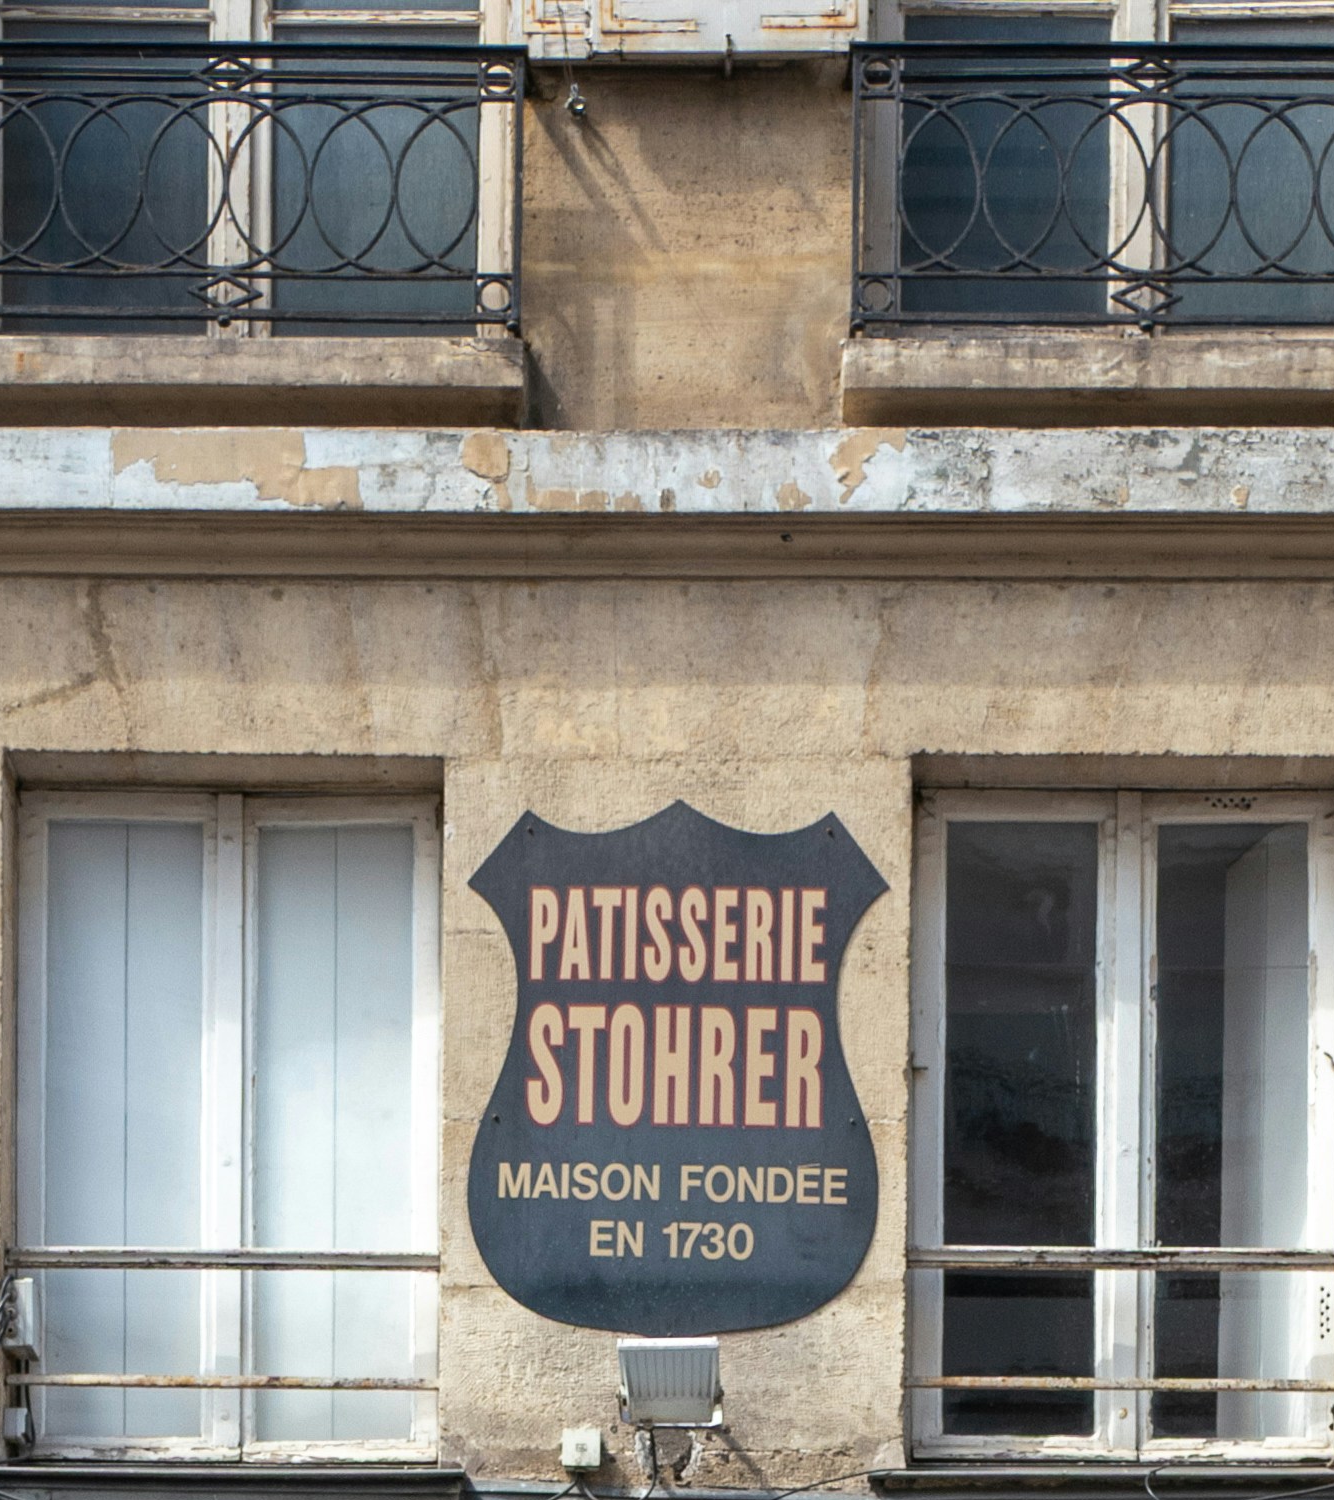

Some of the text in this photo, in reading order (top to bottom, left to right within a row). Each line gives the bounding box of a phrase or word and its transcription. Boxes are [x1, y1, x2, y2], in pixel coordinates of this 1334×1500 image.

[529, 884, 828, 985] PATISSERIE
[526, 1001, 824, 1129] STOHRER
[498, 1162, 848, 1205] MAISON FONDÉE
[589, 1220, 755, 1261] EN 1730
